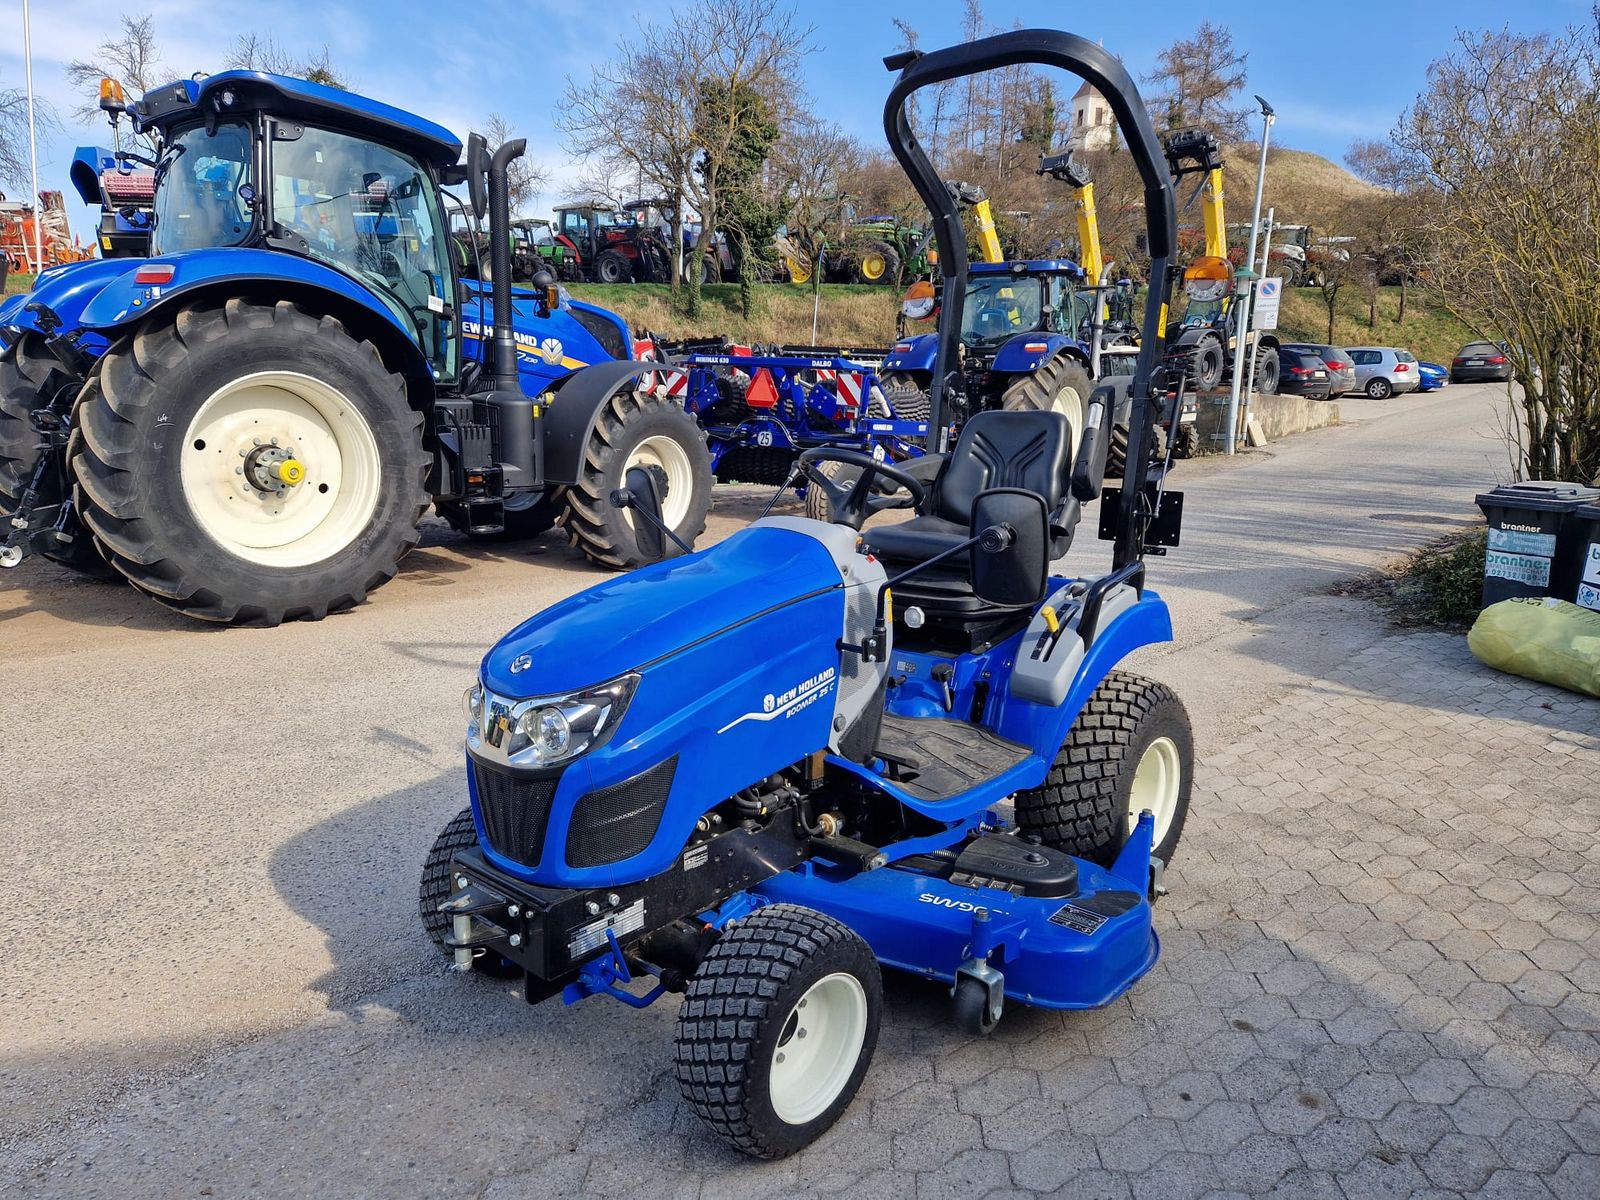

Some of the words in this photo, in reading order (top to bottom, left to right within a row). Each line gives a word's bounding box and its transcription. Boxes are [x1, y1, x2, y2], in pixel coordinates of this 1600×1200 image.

[462, 321, 480, 334] EW
[483, 327, 537, 347] HAND
[811, 360, 832, 368] DALBO
[760, 432, 770, 446] 25
[1501, 521, 1542, 533] brantner
[1487, 551, 1550, 569] brantner
[777, 687, 797, 708] NEW
[798, 667, 835, 695] HOLLAND
[786, 693, 818, 718] BOOMER
[819, 685, 828, 698] 25
[829, 683, 835, 691] C
